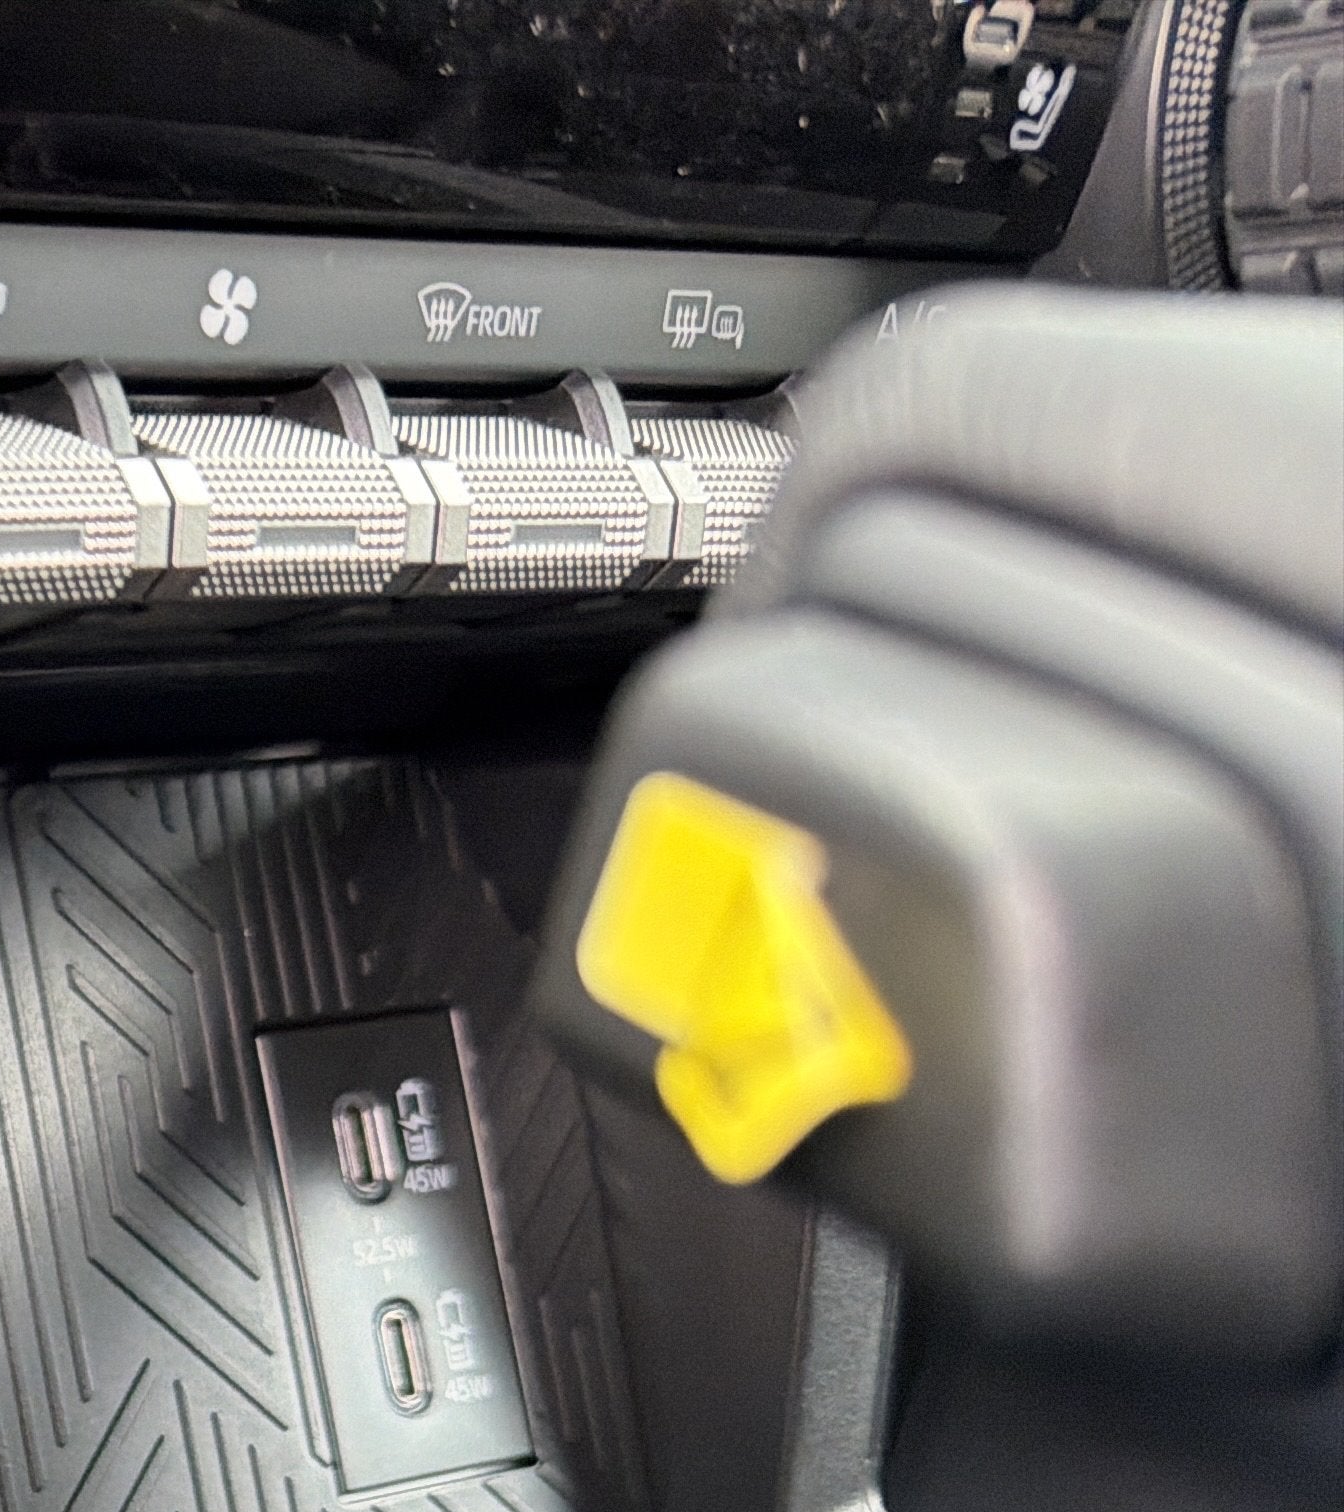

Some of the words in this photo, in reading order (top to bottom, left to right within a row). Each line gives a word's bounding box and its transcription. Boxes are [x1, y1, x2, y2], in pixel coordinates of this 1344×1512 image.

[465, 304, 543, 337] FRONT
[403, 1164, 454, 1192] 45W
[445, 1374, 494, 1402] 45W
